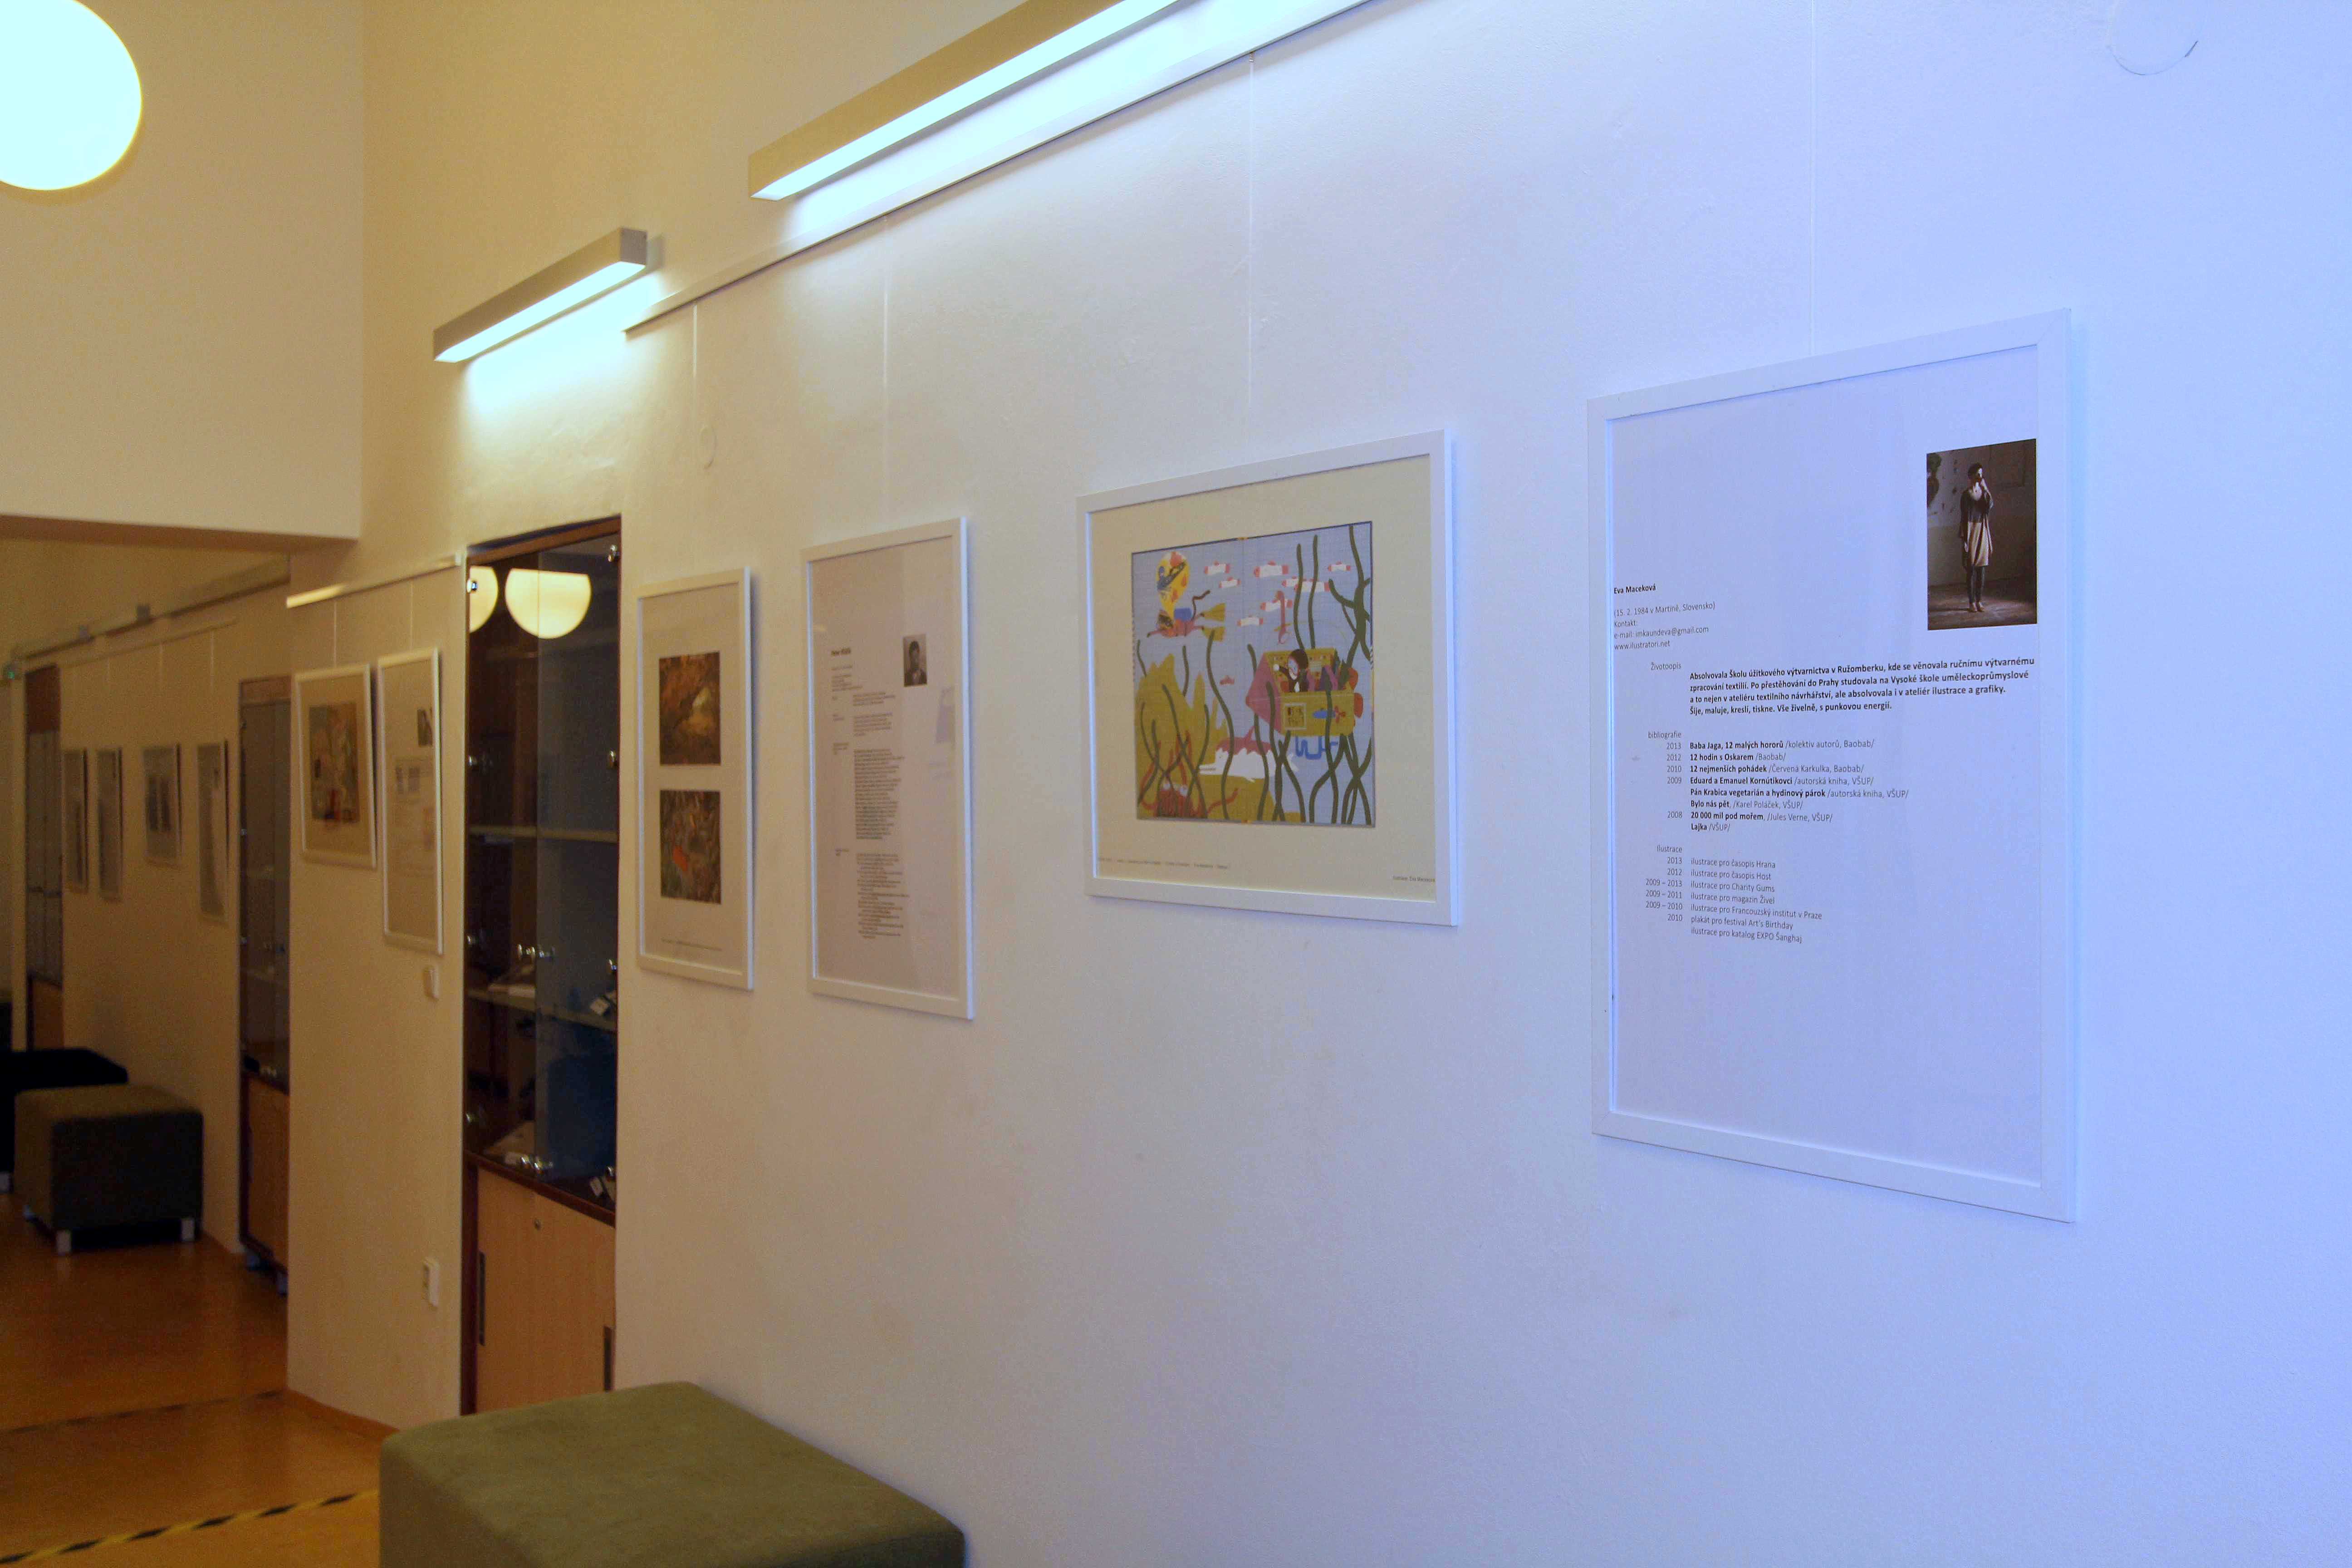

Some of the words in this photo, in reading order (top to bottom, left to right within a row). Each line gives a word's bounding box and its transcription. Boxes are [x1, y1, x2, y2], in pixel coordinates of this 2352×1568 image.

[1626, 584, 1656, 593] Maceková
[1683, 602, 1715, 611] Slovensko)
[1615, 641, 1670, 650] www.ilustratori.net
[1651, 662, 1681, 671] Životoopis
[1690, 671, 1727, 680] Absolvovala
[1729, 669, 1747, 678] Školu
[1838, 663, 1886, 672] Ružomberku,
[1913, 661, 1947, 669] věnovala
[1950, 660, 1982, 668] ručnímu
[1985, 658, 2034, 667] výtvarnému
[1690, 683, 1724, 692] zpracování
[1819, 679, 1838, 688] Prahy
[1841, 676, 1877, 686] studovala
[1891, 675, 1916, 684] Vysoké
[1920, 674, 1939, 682] škole
[1942, 670, 2029, 681] uměleckoprůmyslové
[1704, 695, 1721, 704] nejen
[1729, 693, 1754, 701] ateliéru
[1757, 692, 1789, 701] textilního
[1848, 689, 1892, 698] absolvovala
[1906, 686, 1930, 695] ateliér
[1932, 686, 1965, 695] ilustrace
[1976, 686, 2005, 695] grafiky.
[1690, 706, 1703, 715] Šije,
[1705, 706, 1729, 715] maluje,
[1778, 704, 1789, 712] Vše
[1792, 701, 1818, 713] živelně,
[1826, 703, 1861, 713] punkovou
[1648, 731, 1681, 739] bibliografie
[1735, 741, 1758, 750] malých
[1844, 740, 1875, 748] Baobab/
[1755, 753, 1786, 761] /Baobab/
[1700, 765, 1735, 774] nejmenších
[1738, 765, 1767, 773] pohádek
[1769, 764, 1798, 773] /Červená
[1801, 765, 1831, 773] Karkulka,
[1834, 765, 1864, 773] Baobab/
[1794, 777, 1826, 785] /autorská
[1828, 777, 1849, 786] kniha,
[1852, 777, 1874, 785] VŠUP/
[1730, 789, 1764, 797] vegetarián
[1772, 789, 1803, 799] hydinový
[1805, 789, 1825, 799] párok
[1828, 789, 1860, 798] /autorská
[1863, 790, 1884, 799] kniha,
[1887, 789, 1909, 799] VŠUP/
[1733, 801, 1752, 809] /Karel
[1783, 801, 1803, 809] VŠUP/
[1725, 813, 1737, 822] pod
[1788, 814, 1809, 822] Verne,
[1812, 813, 1833, 823] VŠUP/
[1709, 823, 1730, 831] /VŠUP/
[1732, 859, 1754, 868] časopis
[1720, 871, 1730, 879] pro
[1732, 872, 1754, 880] časopis
[1691, 881, 1717, 889] ilustrace
[1720, 882, 1730, 891] pro
[1732, 883, 1754, 892] Charity
[1691, 904, 1717, 912] ilustrace
[1732, 907, 1770, 917] Francouzský
[1804, 911, 1822, 920] Praze
[1691, 916, 1709, 925] plakát
[1724, 917, 1746, 926] festival
[1766, 921, 1793, 930] Birthday
[1720, 930, 1730, 938] pro
[1732, 930, 1754, 940] katalog
